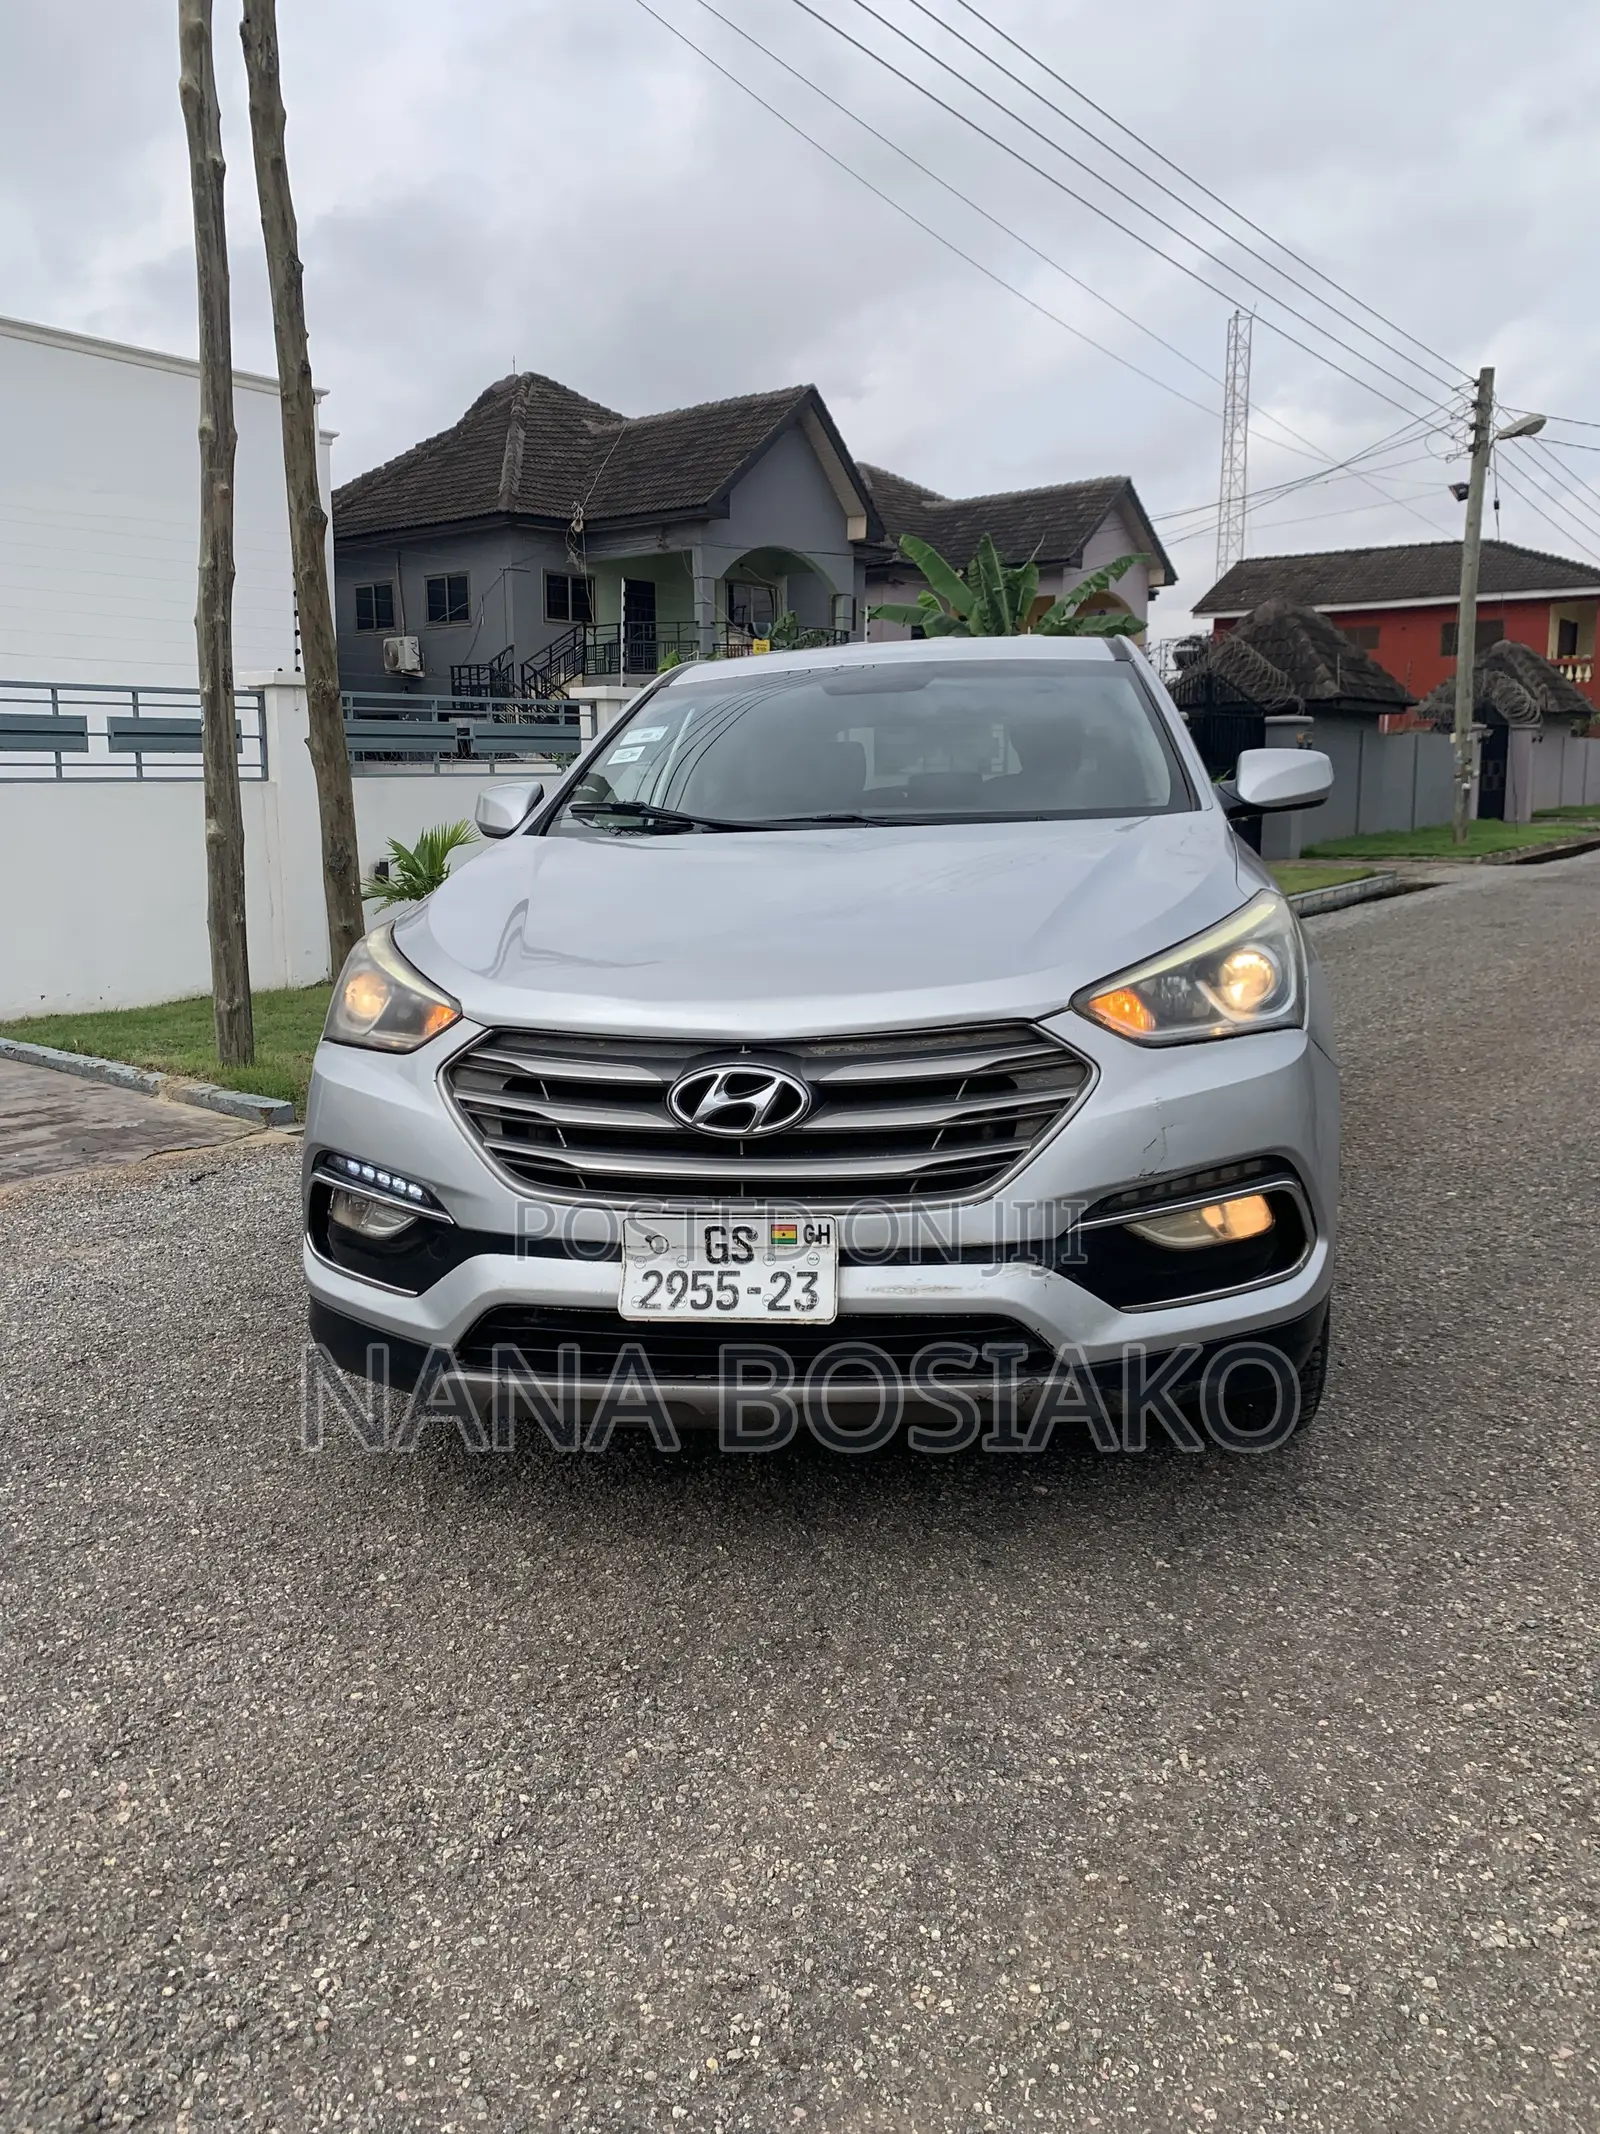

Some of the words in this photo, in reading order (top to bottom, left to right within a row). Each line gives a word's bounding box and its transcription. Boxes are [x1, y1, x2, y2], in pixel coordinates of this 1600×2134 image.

[704, 1225, 755, 1265] GS
[803, 1223, 831, 1245] GH
[641, 1269, 820, 1312] 2955-23
